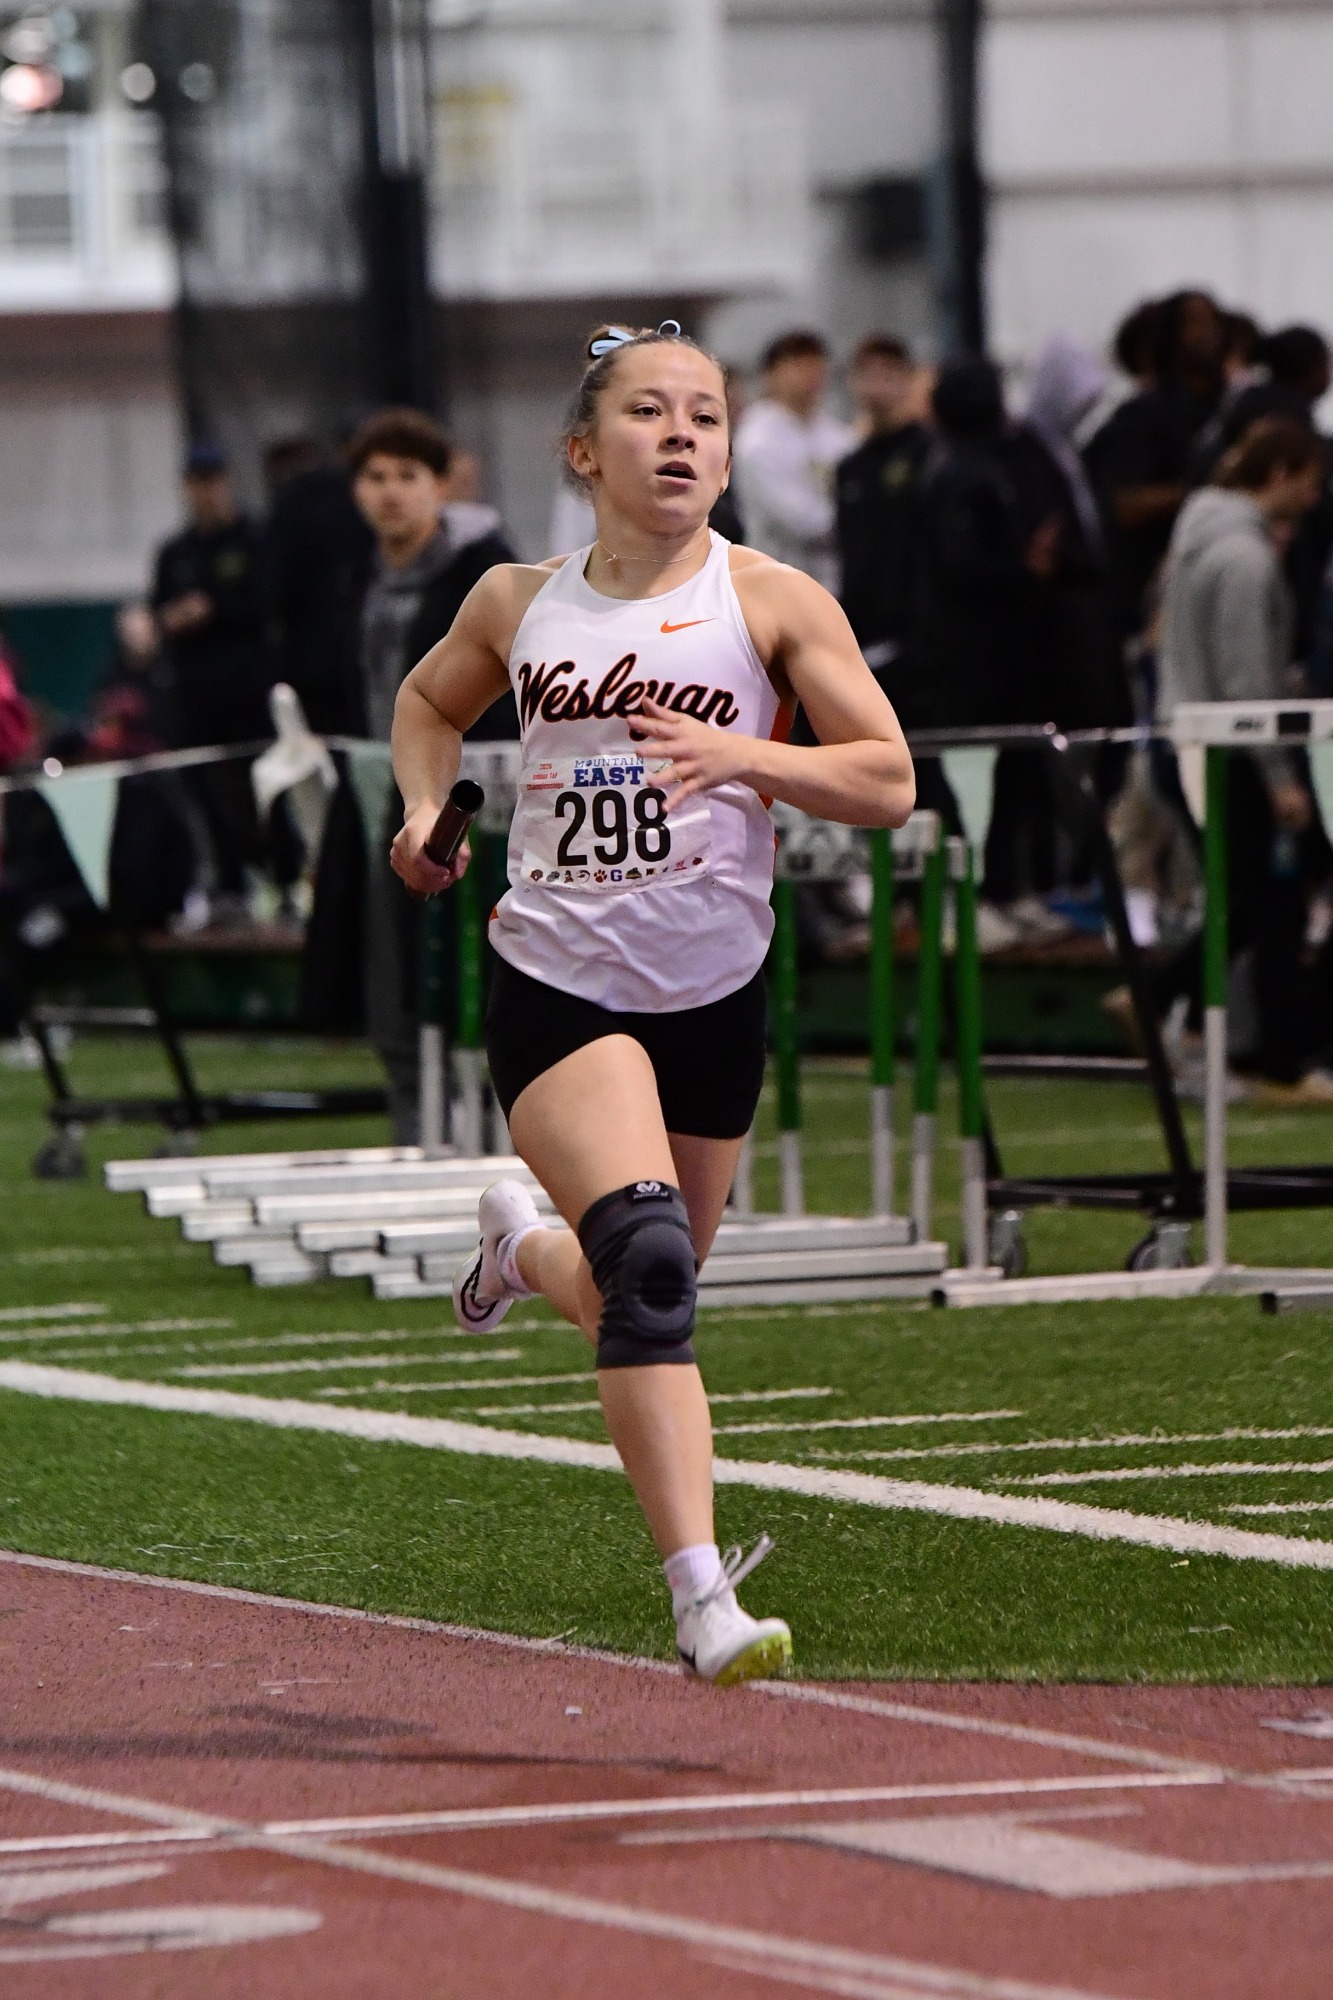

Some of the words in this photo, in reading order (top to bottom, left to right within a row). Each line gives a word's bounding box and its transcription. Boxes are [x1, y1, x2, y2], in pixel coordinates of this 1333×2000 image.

[517, 652, 740, 742] Wesleyan
[573, 766, 645, 787] EAST
[554, 787, 671, 867] 298
[610, 869, 622, 882] G
